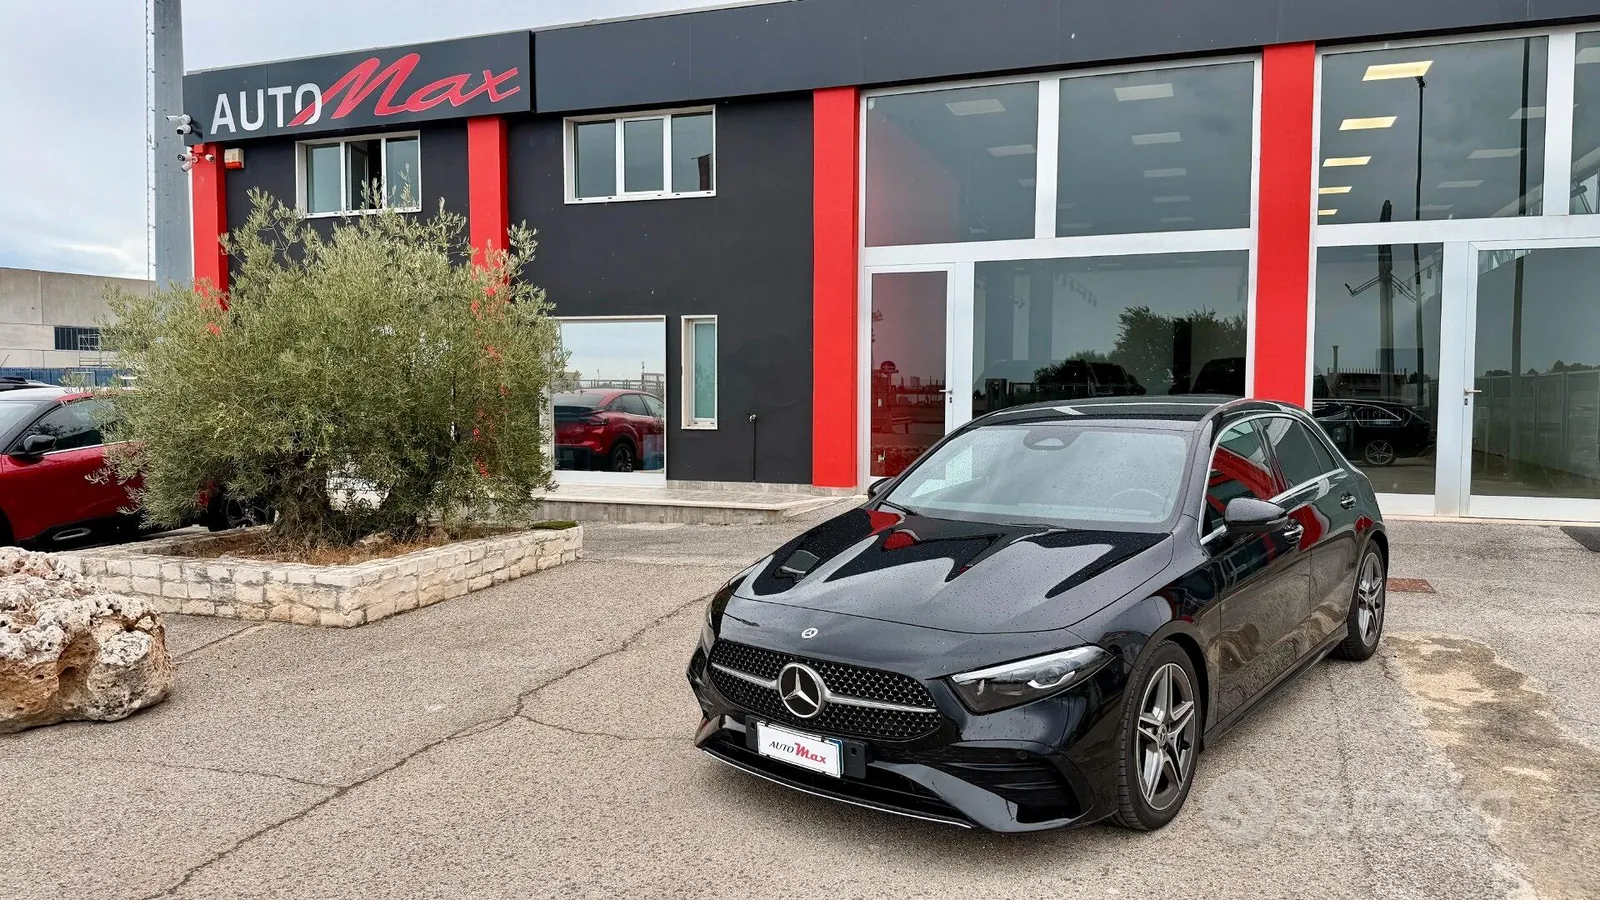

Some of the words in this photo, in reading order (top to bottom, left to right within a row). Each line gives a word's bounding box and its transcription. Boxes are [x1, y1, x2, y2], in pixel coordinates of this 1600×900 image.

[210, 82, 323, 135] AUTO
[287, 52, 521, 128] Max
[769, 741, 795, 754] AUTO
[794, 742, 827, 765] Max
